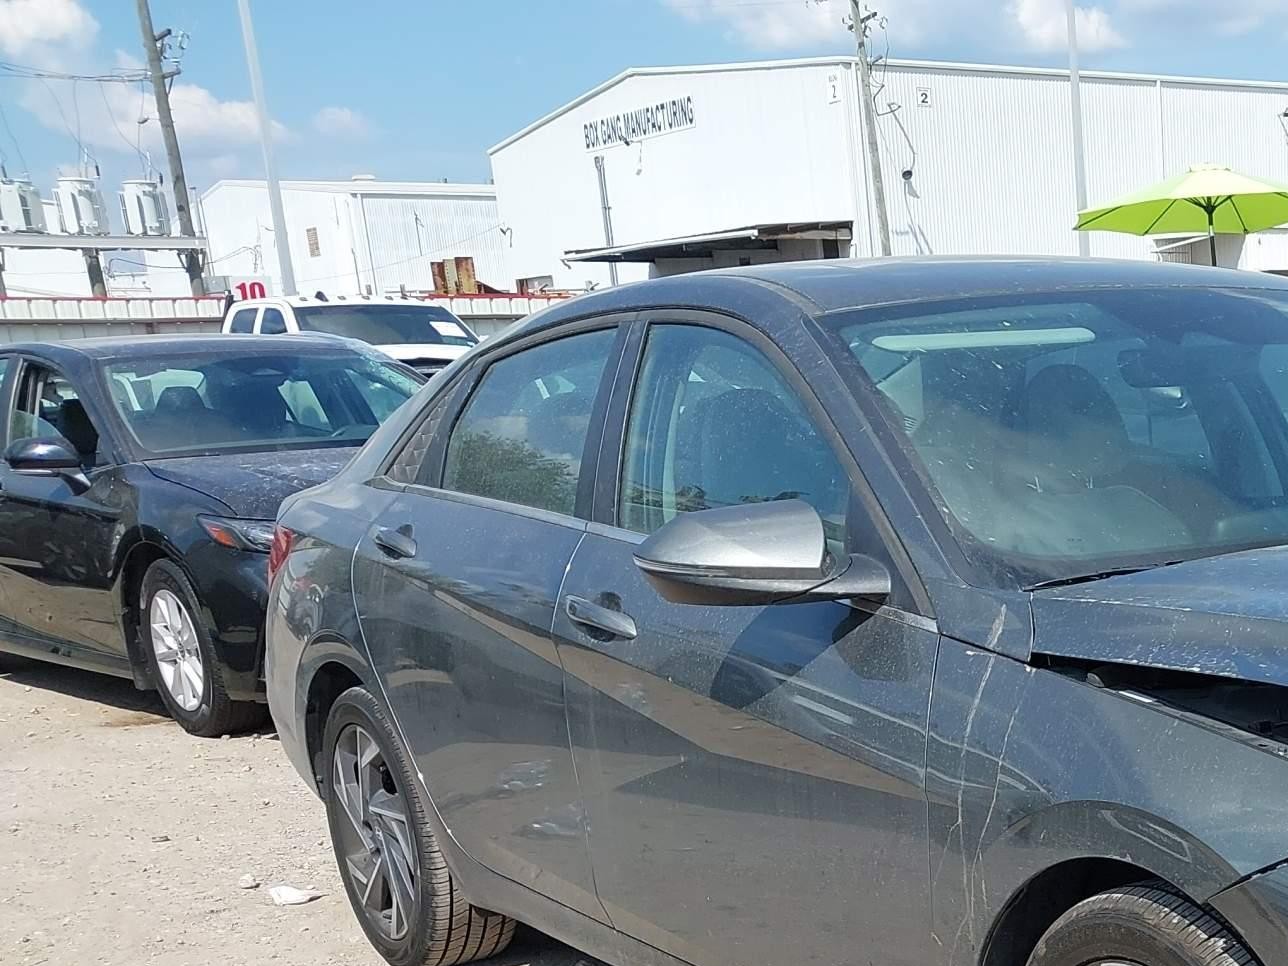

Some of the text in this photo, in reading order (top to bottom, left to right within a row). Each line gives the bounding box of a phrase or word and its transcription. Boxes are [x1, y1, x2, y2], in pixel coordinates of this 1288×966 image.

[920, 92, 929, 104] 2
[584, 119, 601, 149] BOX
[623, 96, 693, 139] MANUFACTURING
[235, 282, 266, 300] 10
